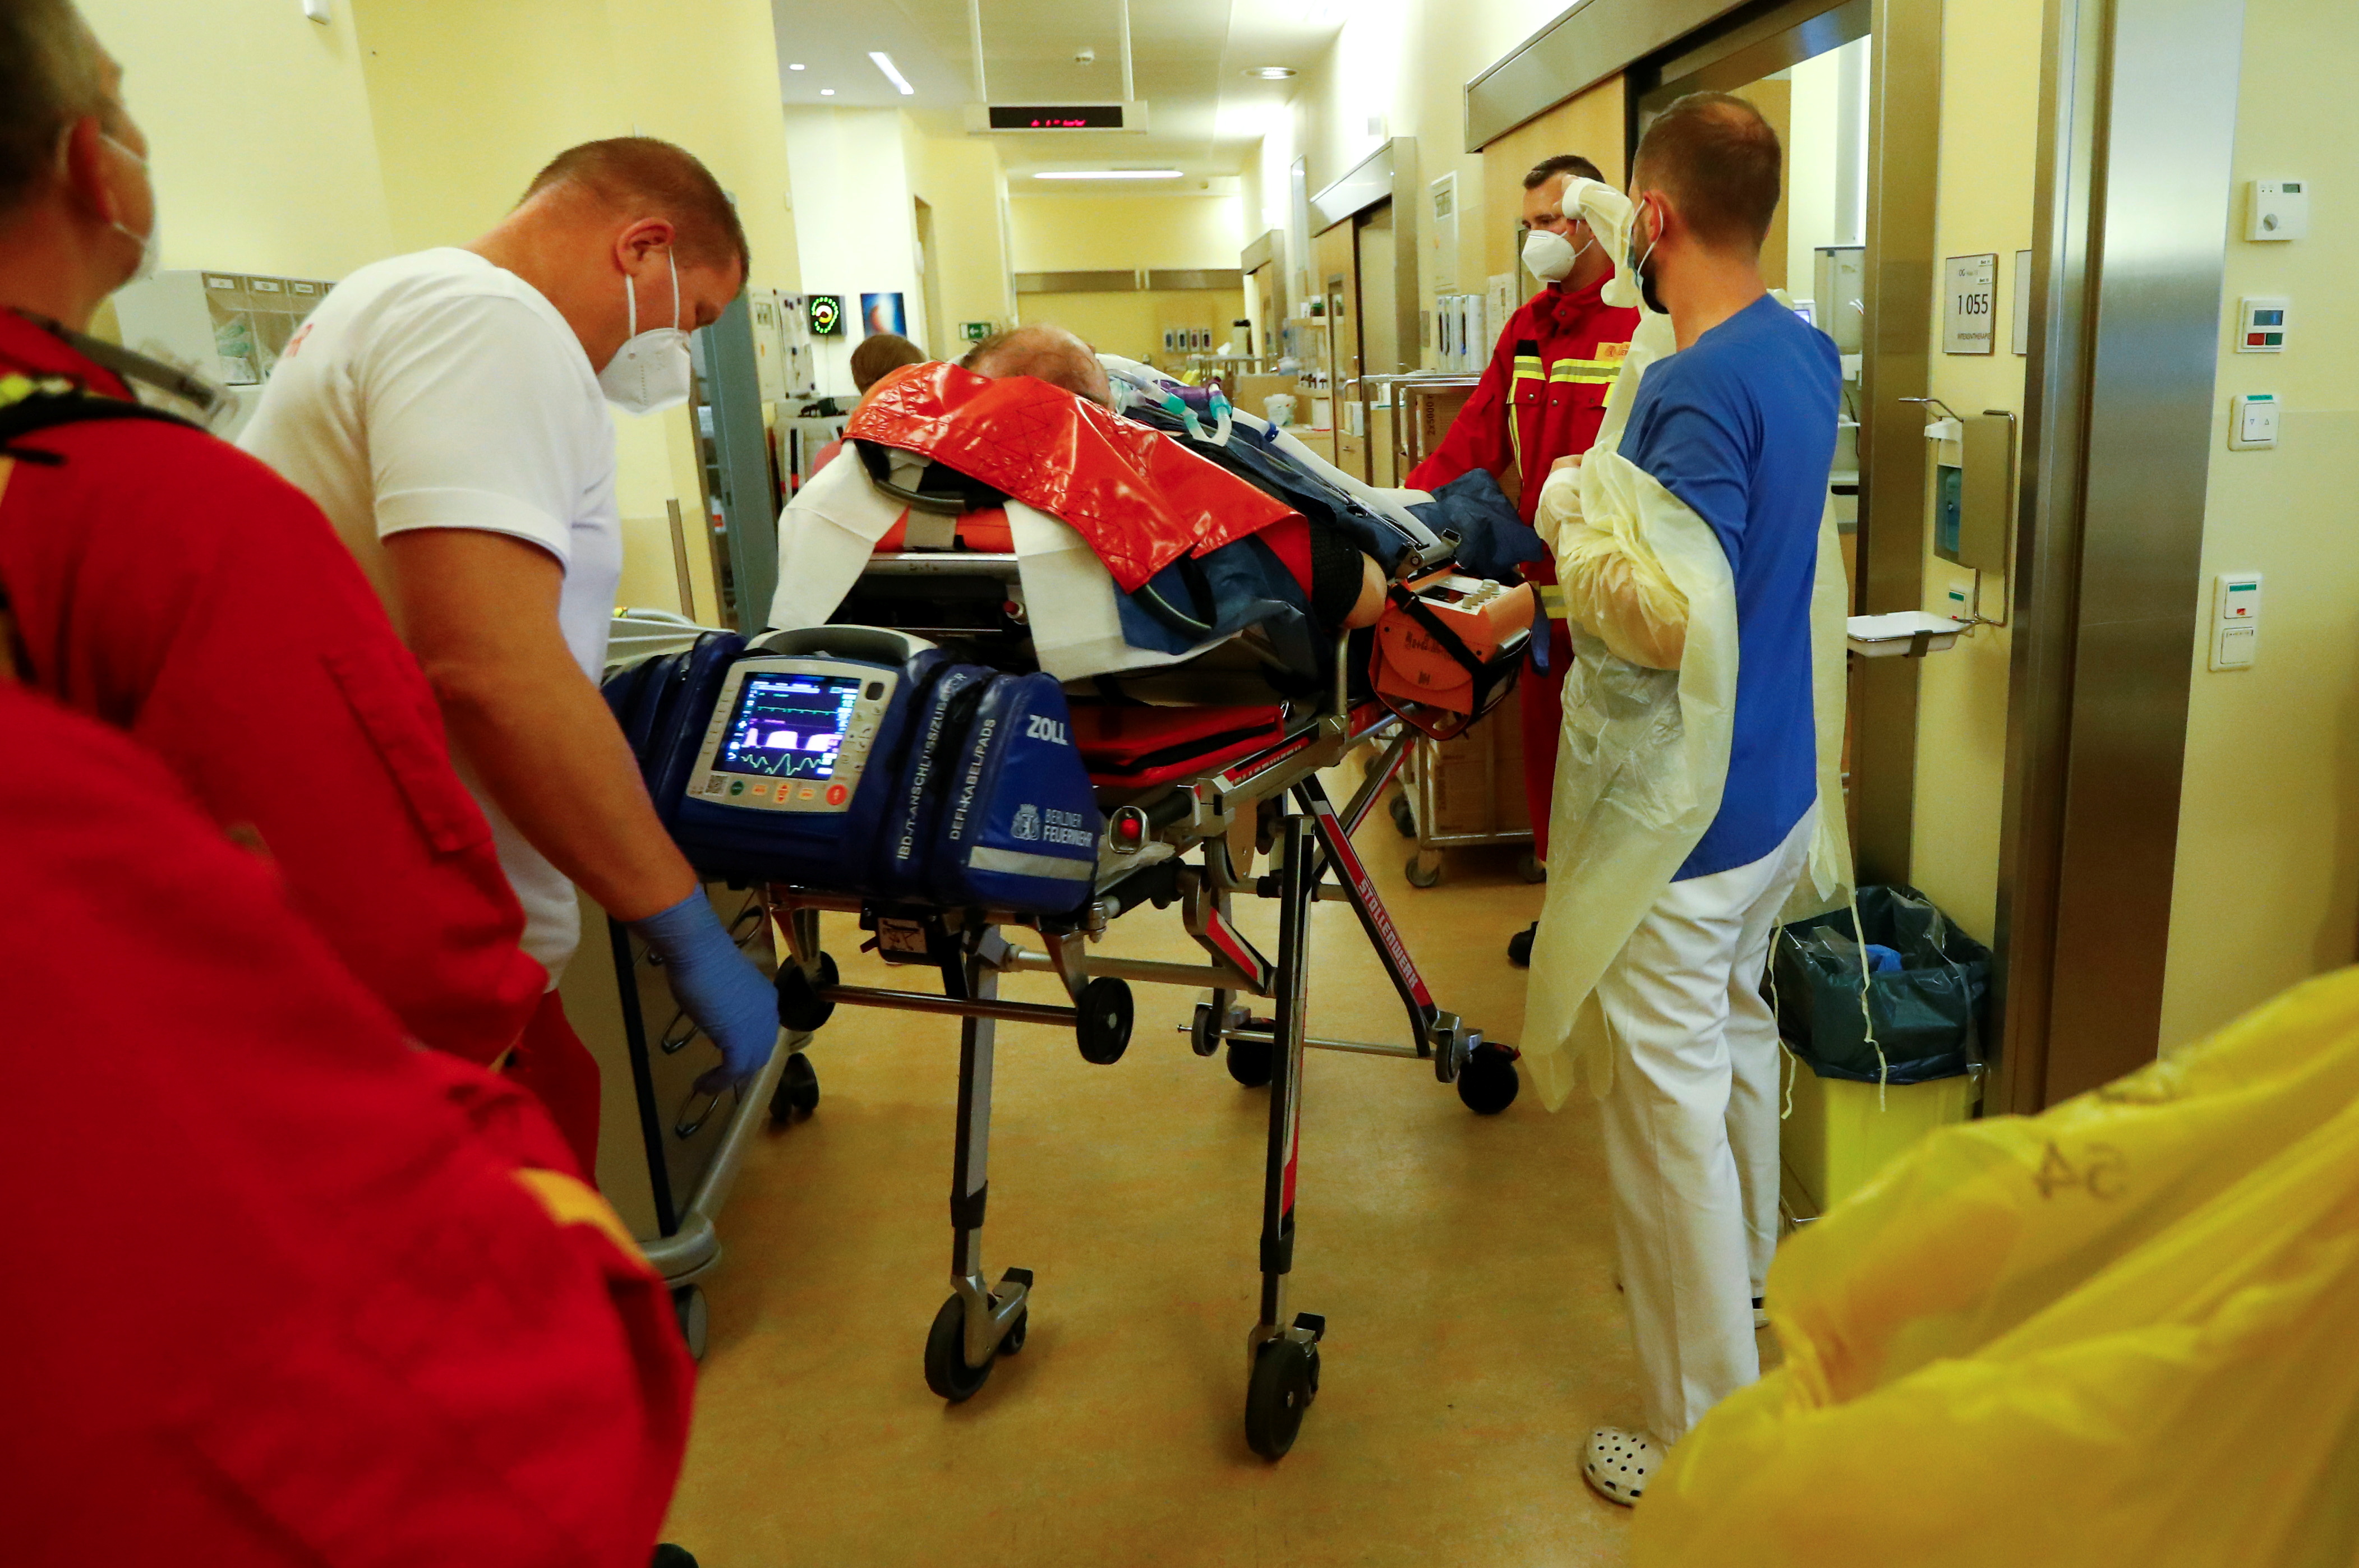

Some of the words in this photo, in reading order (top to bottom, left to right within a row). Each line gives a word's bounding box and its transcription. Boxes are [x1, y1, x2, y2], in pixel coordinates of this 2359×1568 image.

[1026, 714, 1068, 745] ZOLL
[1045, 808, 1082, 828] BERLINER
[1043, 825, 1094, 848] FEUERWEHR
[1358, 879, 1418, 989] STOLLENWERK
